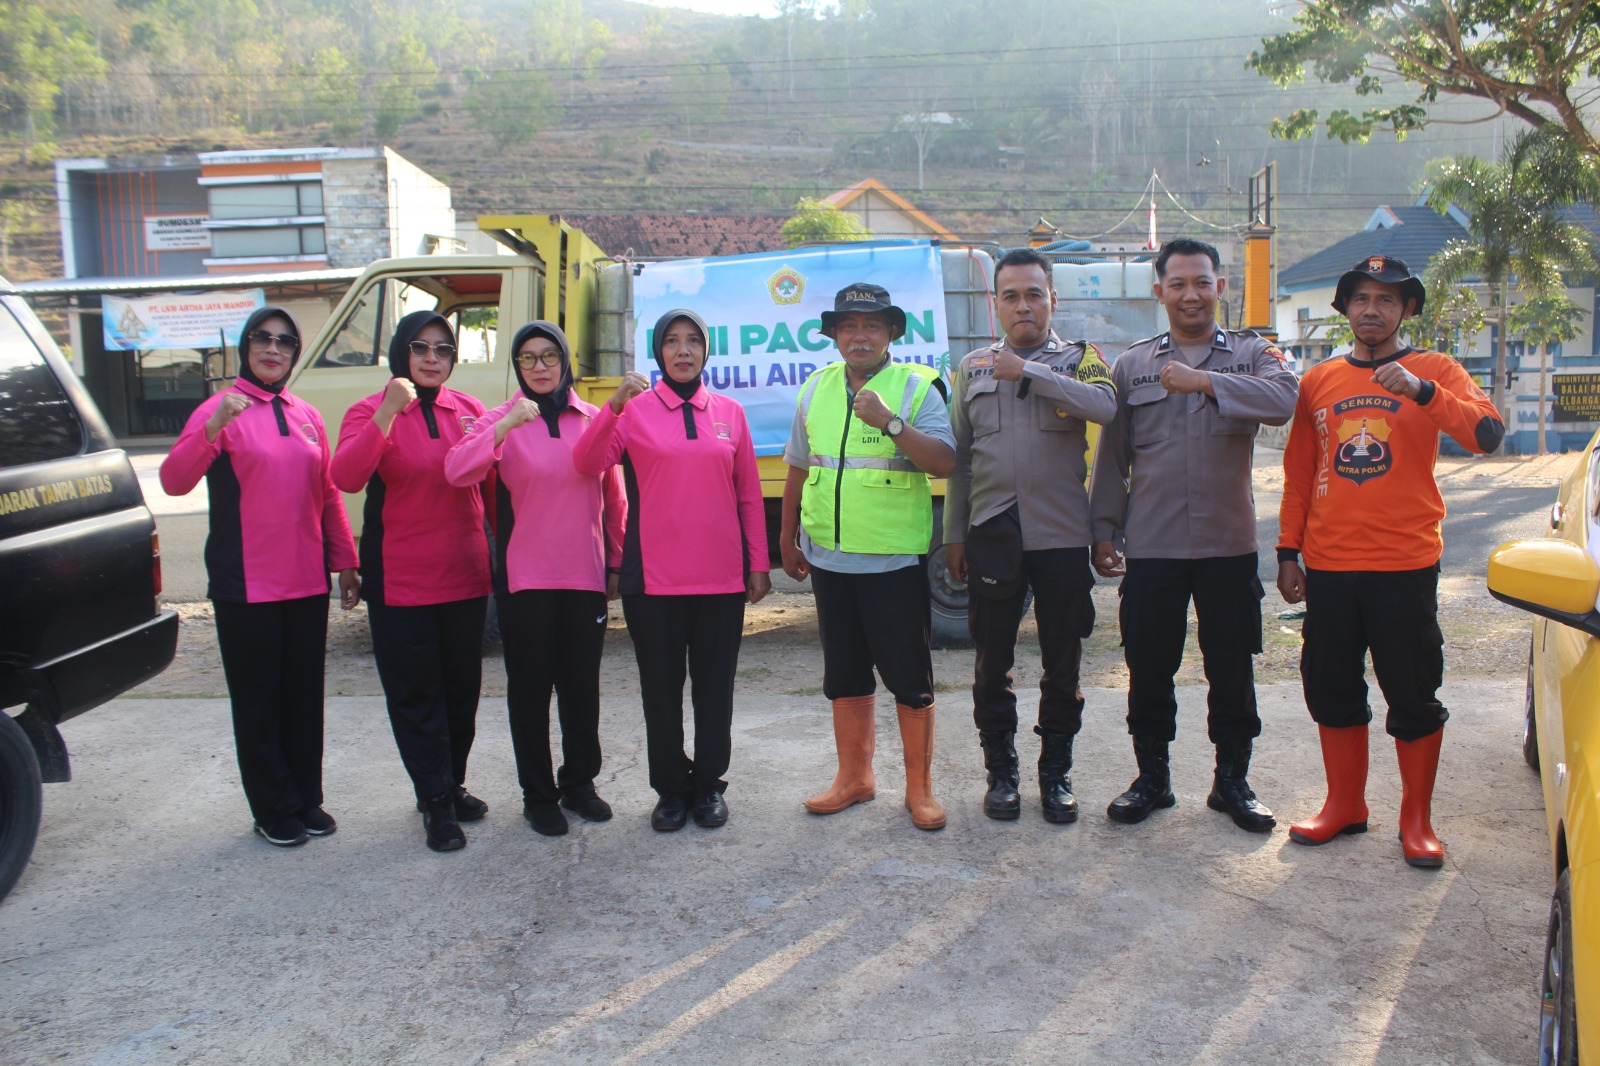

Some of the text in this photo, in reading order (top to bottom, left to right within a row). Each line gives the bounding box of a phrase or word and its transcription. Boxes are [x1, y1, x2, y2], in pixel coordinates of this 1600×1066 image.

[179, 304, 203, 312] ARTHA
[205, 302, 221, 310] JAYA
[740, 310, 935, 354] PACN
[1051, 363, 1076, 373] OLRI
[1561, 384, 1587, 394] BALAI
[1341, 398, 1392, 410] SENKOM
[862, 436, 880, 444] LDII
[1314, 407, 1329, 499] RESCUE
[1337, 464, 1387, 474] MITRA POLRI
[38, 480, 78, 505] TANPA
[77, 474, 113, 498] BATAS
